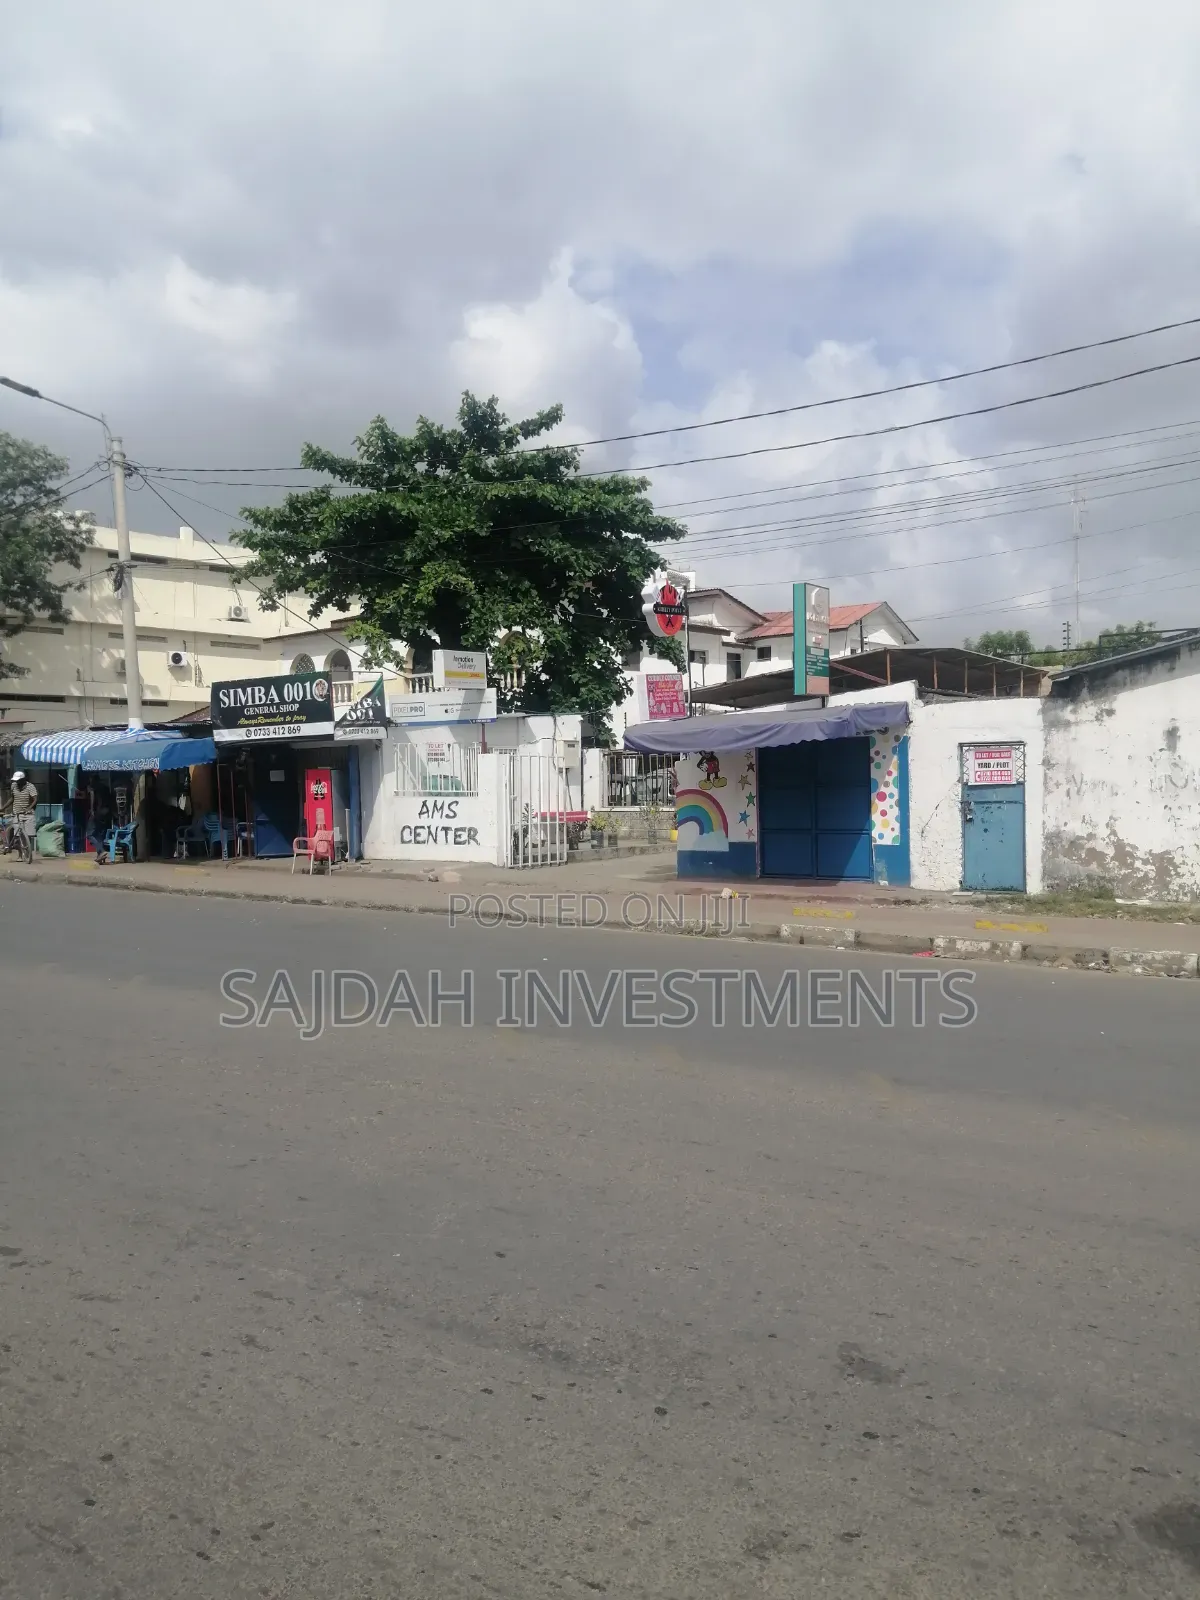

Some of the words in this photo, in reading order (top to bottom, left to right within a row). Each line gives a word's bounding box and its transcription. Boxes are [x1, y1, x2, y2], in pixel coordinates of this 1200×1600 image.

[457, 662, 476, 671] Delivery
[219, 684, 280, 709] SIMBA
[283, 681, 313, 702] 001
[244, 705, 279, 716] GENERAL
[279, 703, 300, 713] SHOP
[393, 705, 424, 714] PIXELPRO
[253, 728, 271, 737] 0733
[272, 727, 286, 736] 412
[287, 725, 301, 734] 869
[418, 799, 459, 819] AMS
[400, 825, 480, 846] CENTER
